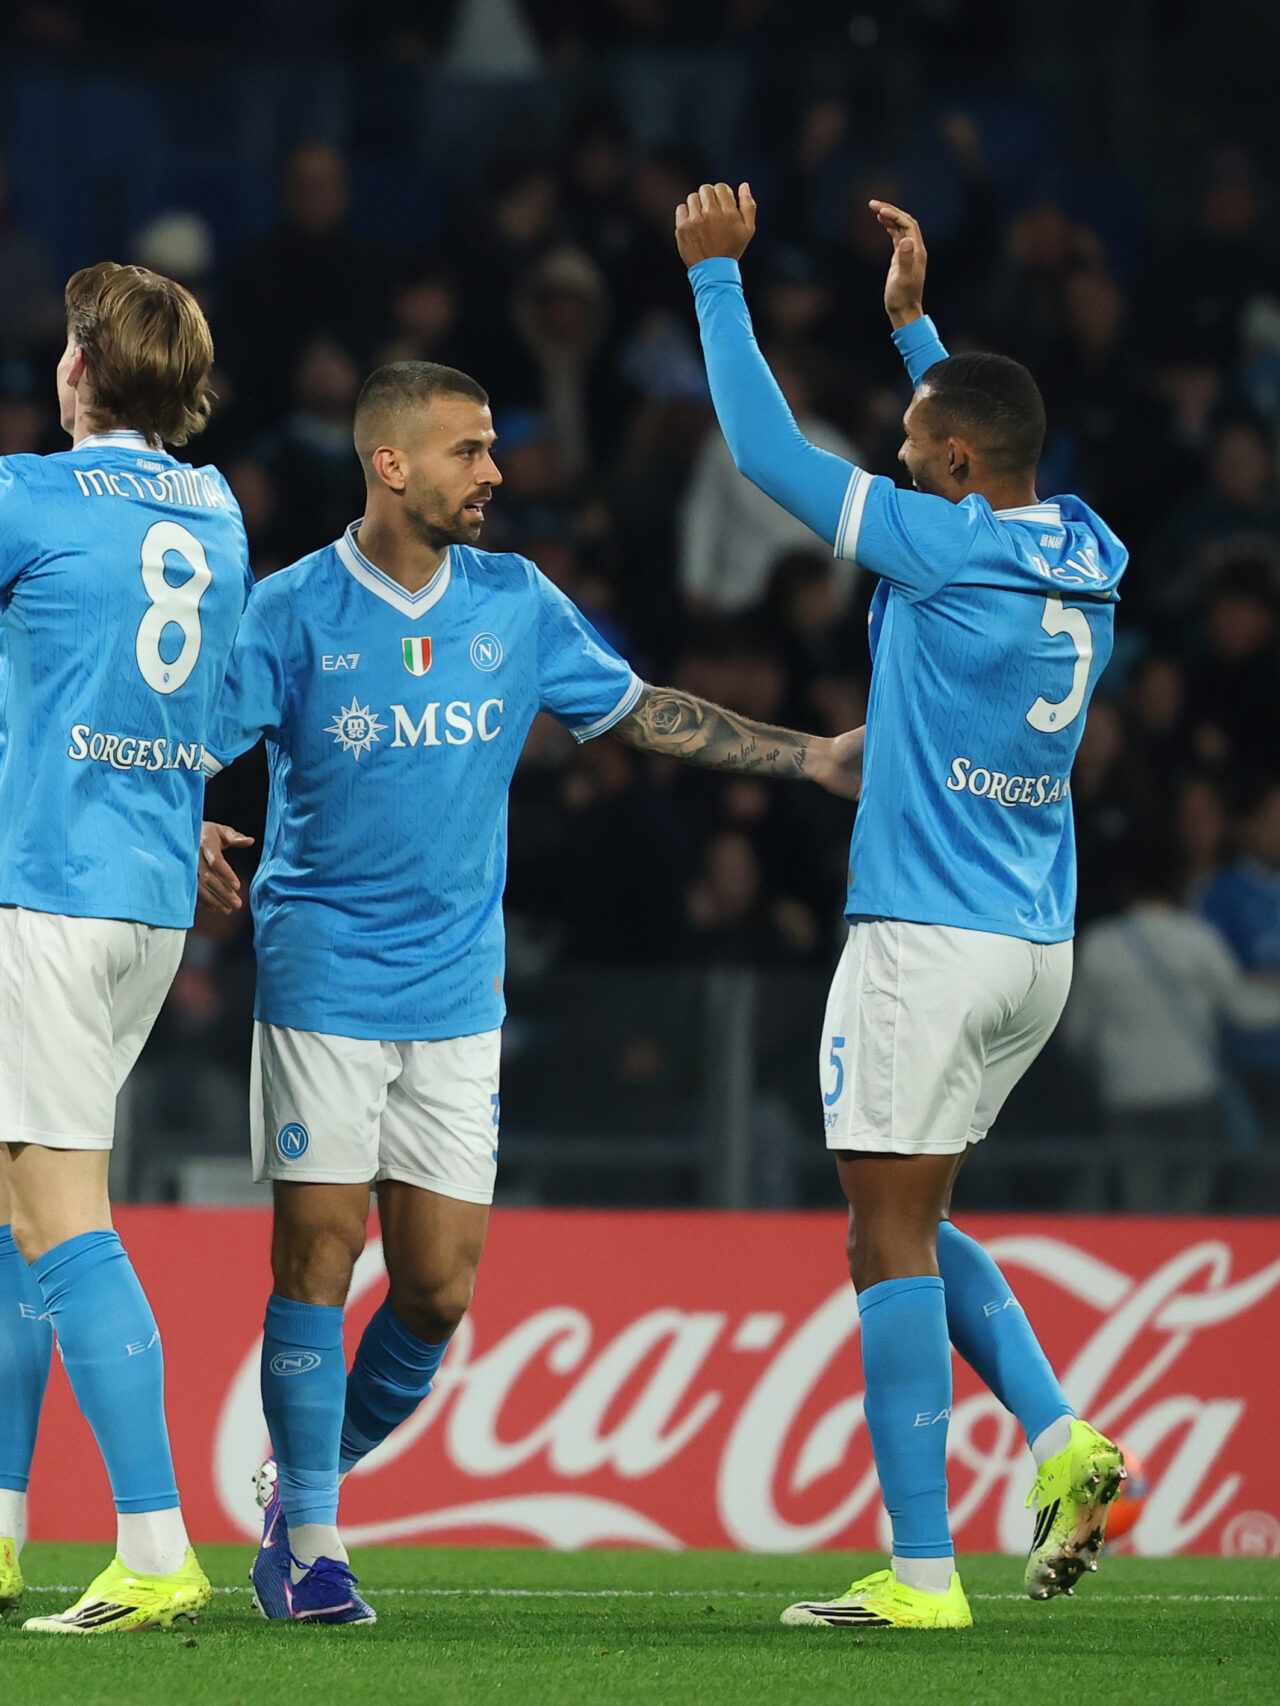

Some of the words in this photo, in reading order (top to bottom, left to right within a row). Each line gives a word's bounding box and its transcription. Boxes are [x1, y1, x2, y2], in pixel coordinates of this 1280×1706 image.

[135, 520, 213, 695] 8
[322, 653, 361, 671] EA7
[1025, 588, 1093, 733] 5
[389, 698, 504, 748] MSC
[824, 1037, 845, 1106] 5
[19, 1303, 56, 1329] EA
[982, 1297, 1023, 1317] EA
[213, 1236, 1280, 1553] Coca-Cola
[913, 1406, 952, 1426] EA
